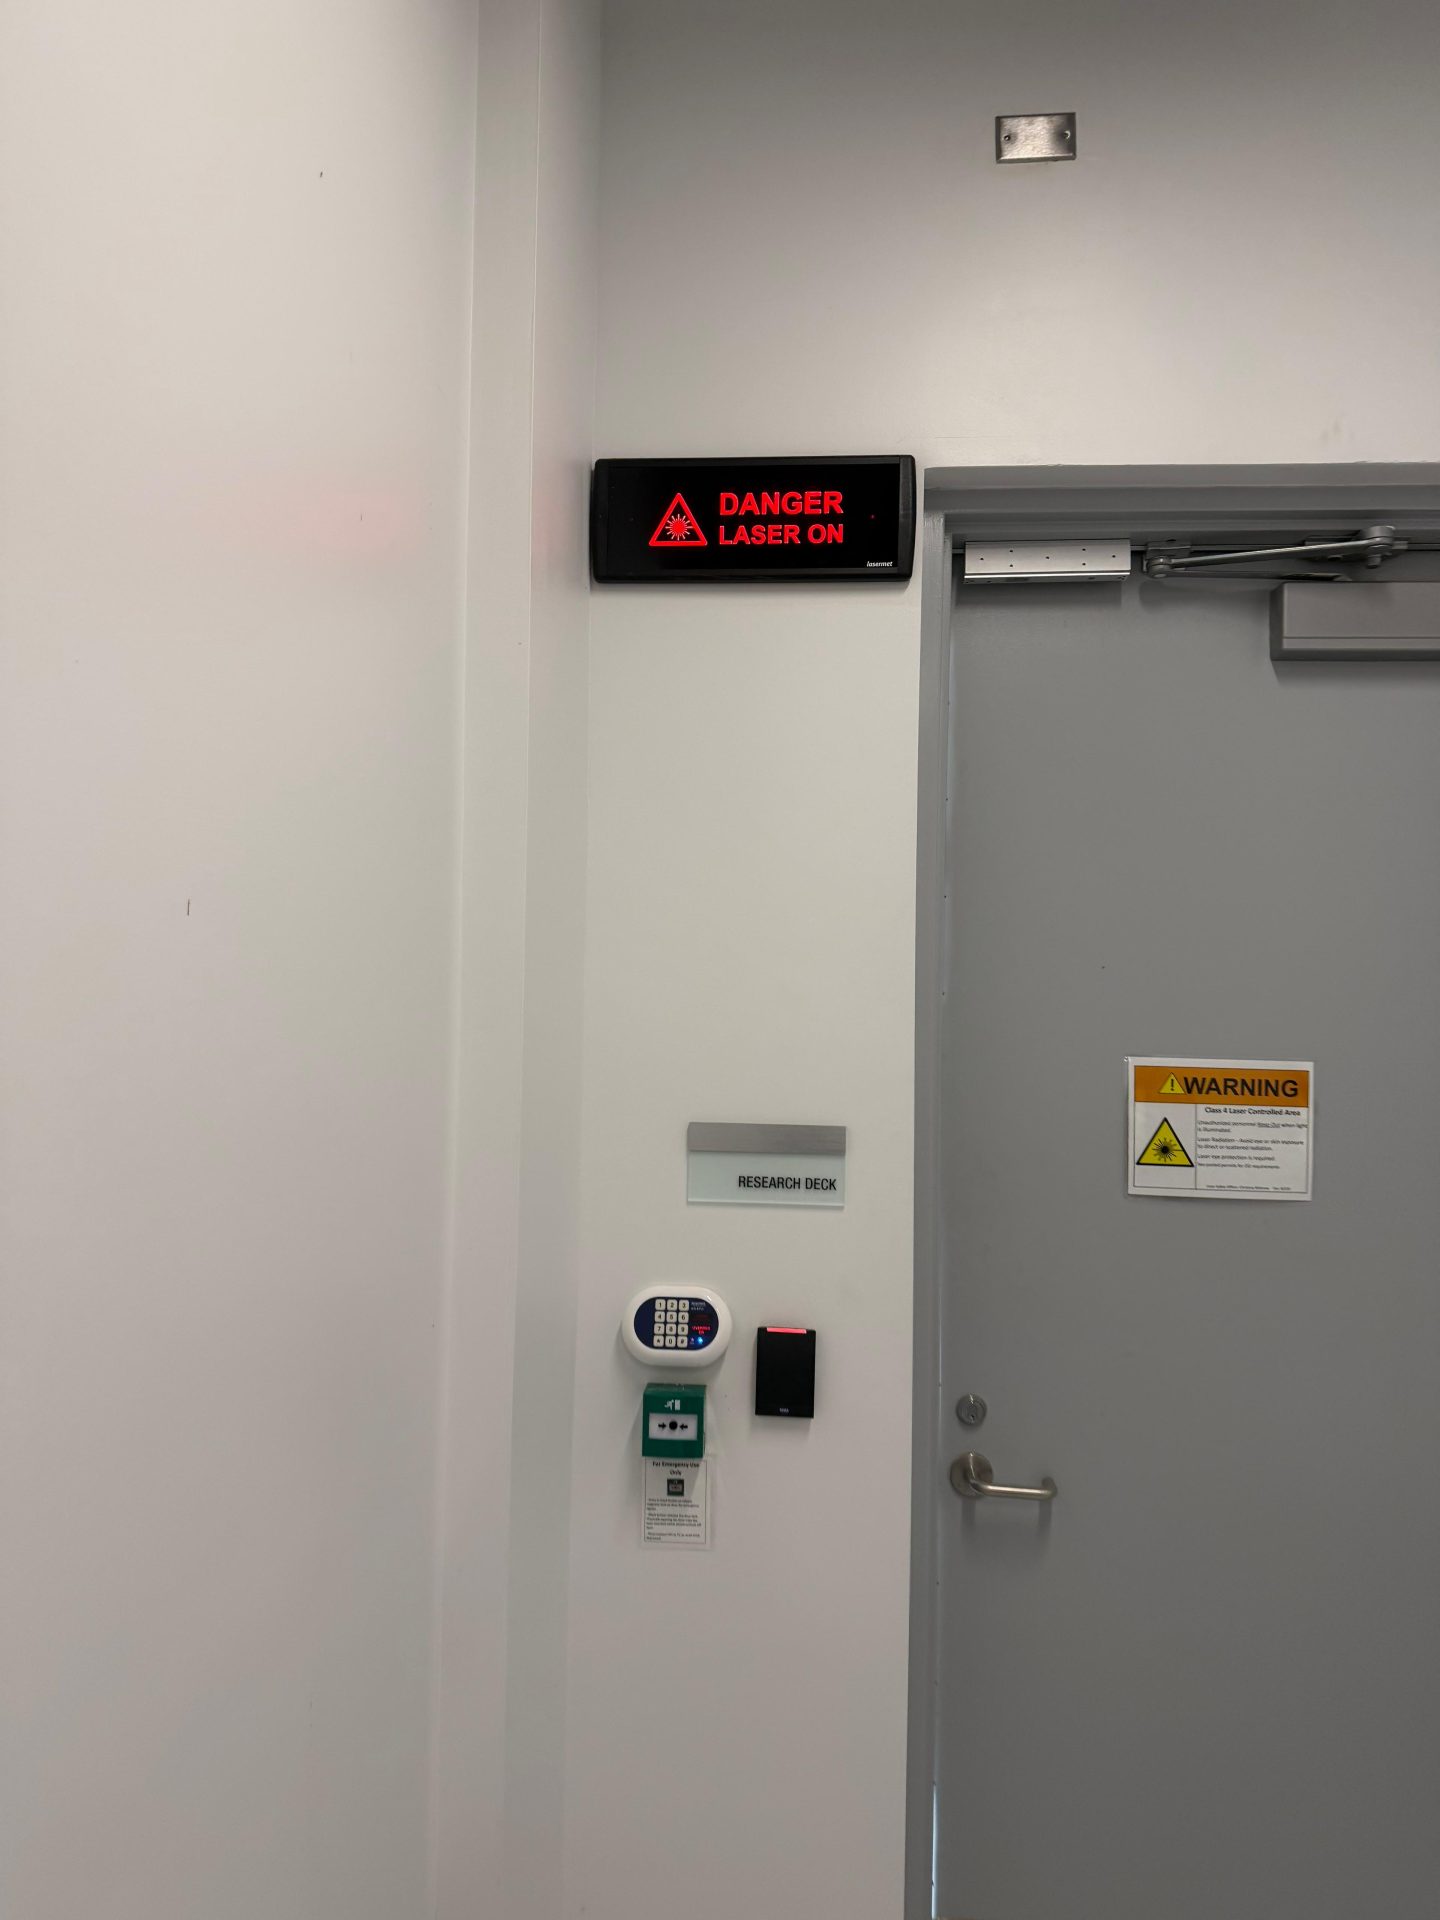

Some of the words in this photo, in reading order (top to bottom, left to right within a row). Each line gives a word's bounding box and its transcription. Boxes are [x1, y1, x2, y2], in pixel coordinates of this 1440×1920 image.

[719, 491, 844, 516] DANGER
[719, 525, 801, 545] LASER
[807, 523, 844, 544] ON
[1183, 1076, 1299, 1098] WARNING
[1204, 1106, 1222, 1114] Class
[1228, 1107, 1247, 1115] Laser
[1247, 1108, 1283, 1116] Controlled
[1284, 1109, 1301, 1117] Area
[738, 1175, 801, 1190] RESEARCH
[805, 1177, 837, 1191] DECK
